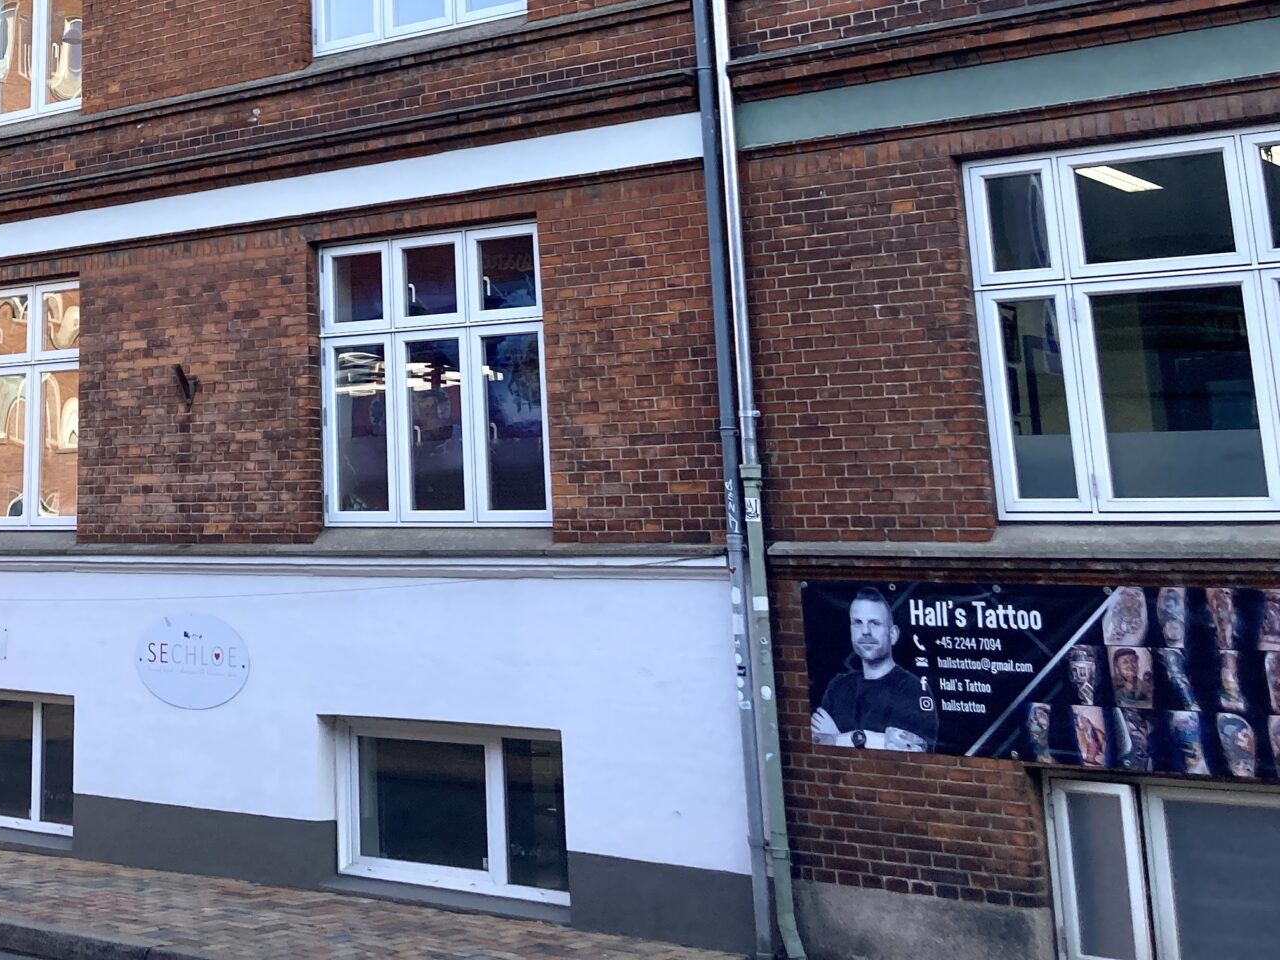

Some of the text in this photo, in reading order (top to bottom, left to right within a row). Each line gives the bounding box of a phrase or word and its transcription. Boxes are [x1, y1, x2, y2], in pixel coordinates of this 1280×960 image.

[909, 599, 1042, 630] Hall's Tattoo
[935, 637, 1001, 651] +45 2244 7094
[937, 656, 1034, 674] hallstattoo@gmail.com
[939, 678, 963, 692] Hall's
[964, 679, 992, 693] Tattoo
[941, 699, 986, 714] hallstattoo
